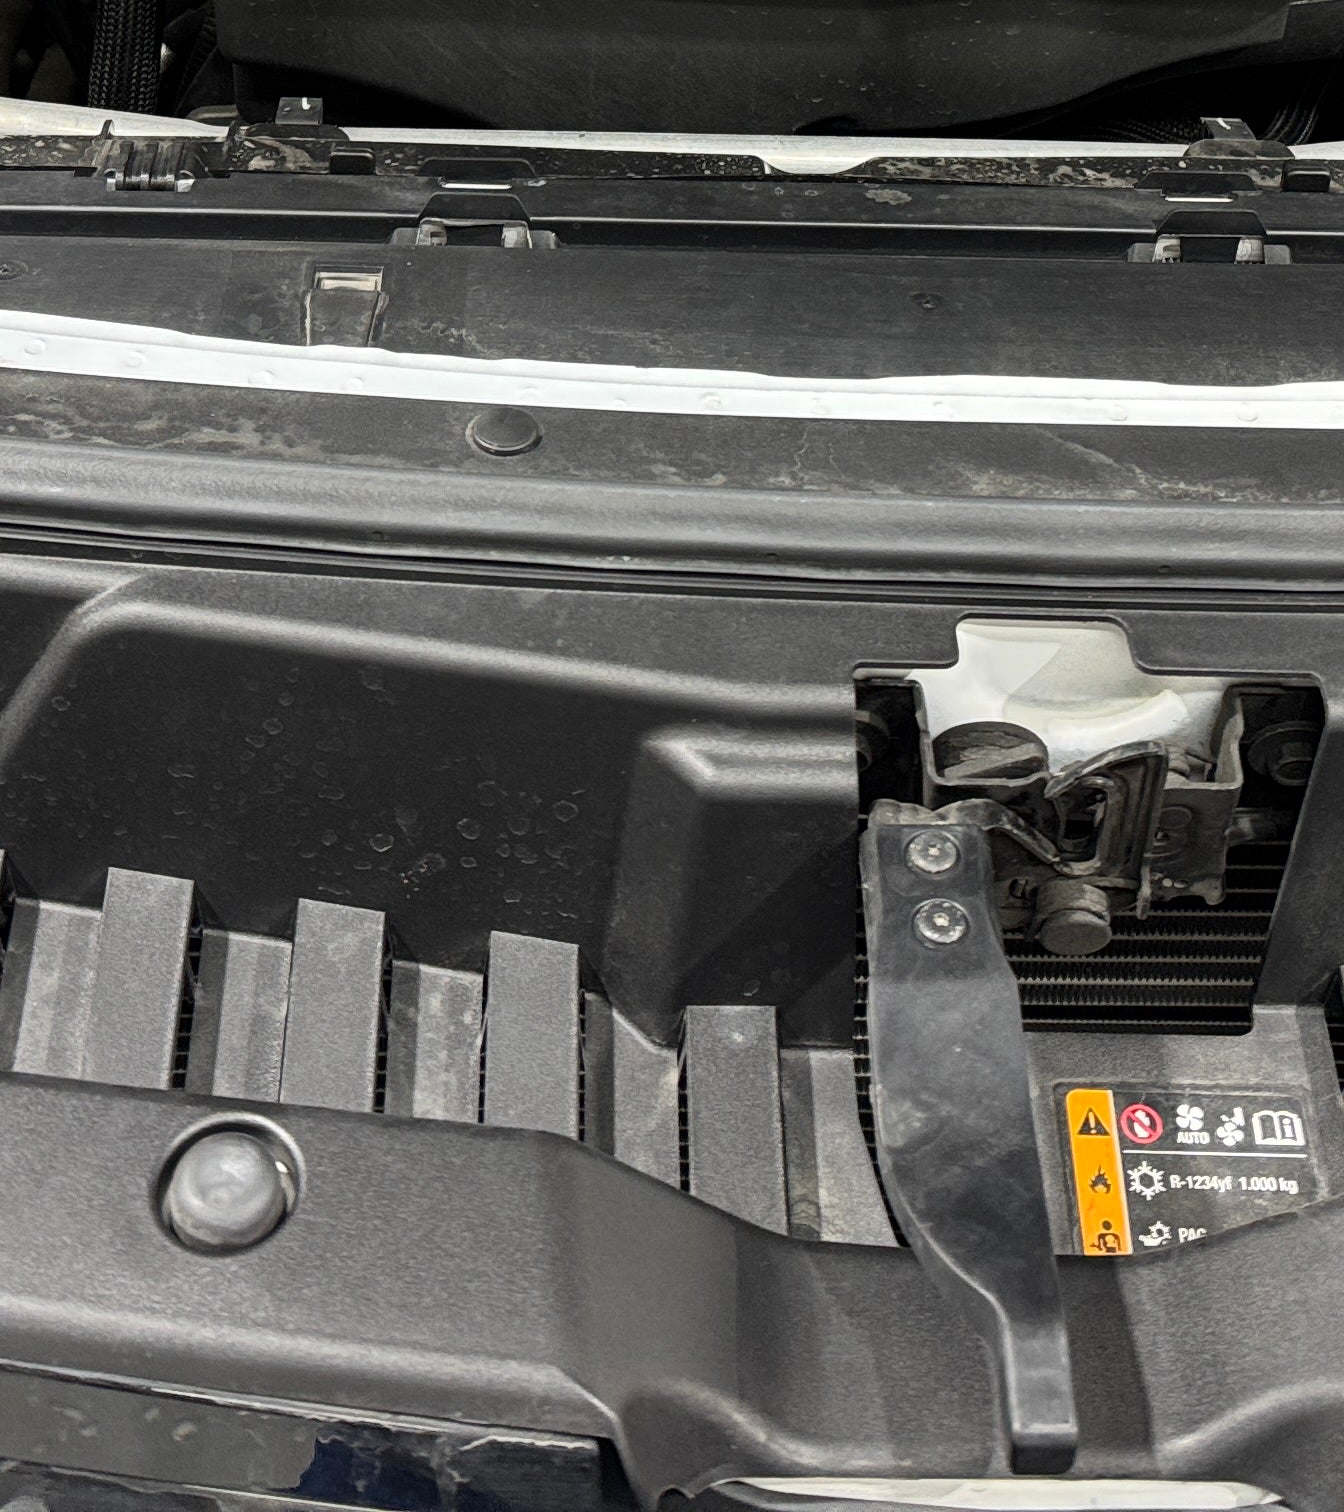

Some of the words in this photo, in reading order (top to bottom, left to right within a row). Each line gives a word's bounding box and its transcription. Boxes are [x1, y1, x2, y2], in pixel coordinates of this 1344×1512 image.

[1177, 1131, 1210, 1144] AUTO
[1170, 1175, 1233, 1192] R-1234yf
[1239, 1176, 1277, 1191] 1.000
[1278, 1177, 1299, 1194] kg
